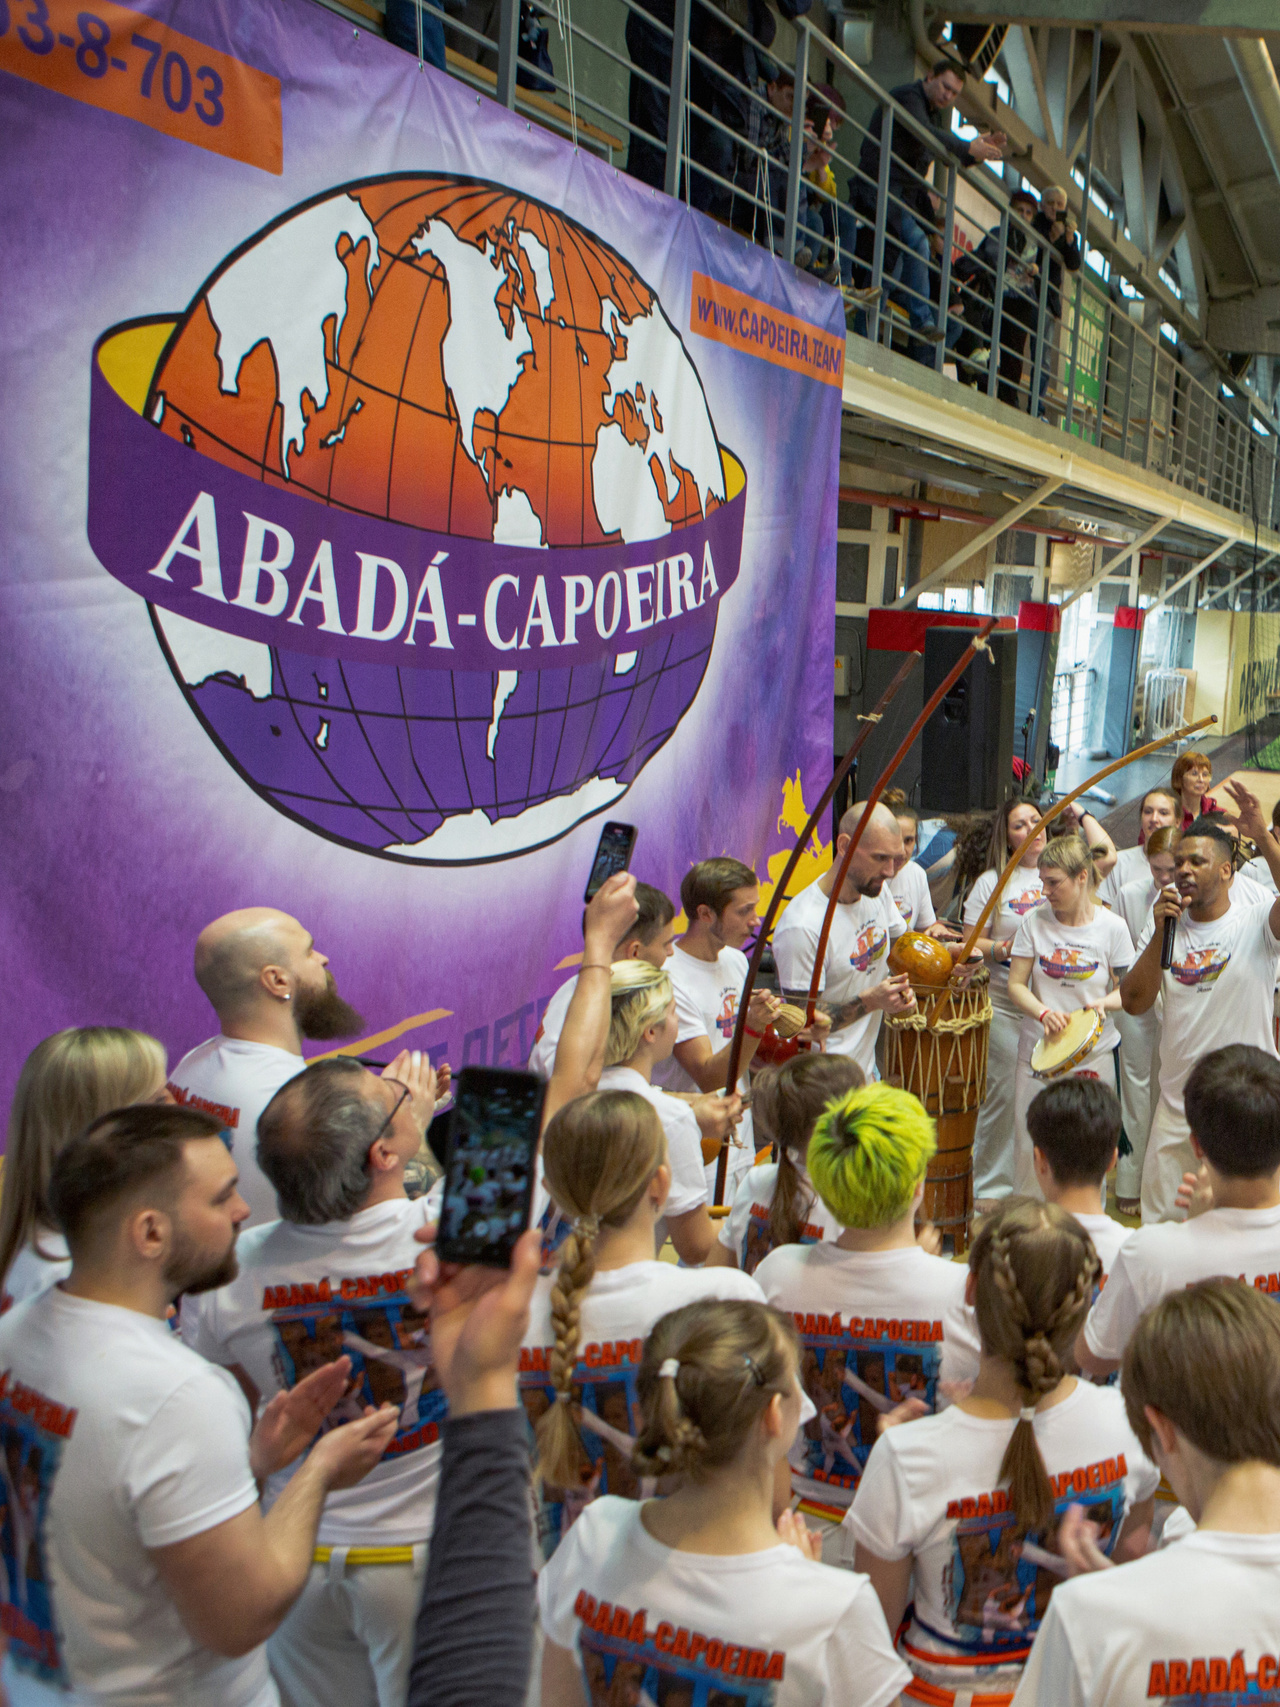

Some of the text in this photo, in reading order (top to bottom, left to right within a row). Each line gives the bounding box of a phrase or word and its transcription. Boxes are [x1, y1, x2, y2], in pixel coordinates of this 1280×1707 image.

[697, 295, 842, 376] WWW.CAPOEIRA.TEAM
[148, 491, 719, 651] ABADÁ-CAPOEIRA
[787, 1311, 944, 1342] BADÁ-CAPOEIRA
